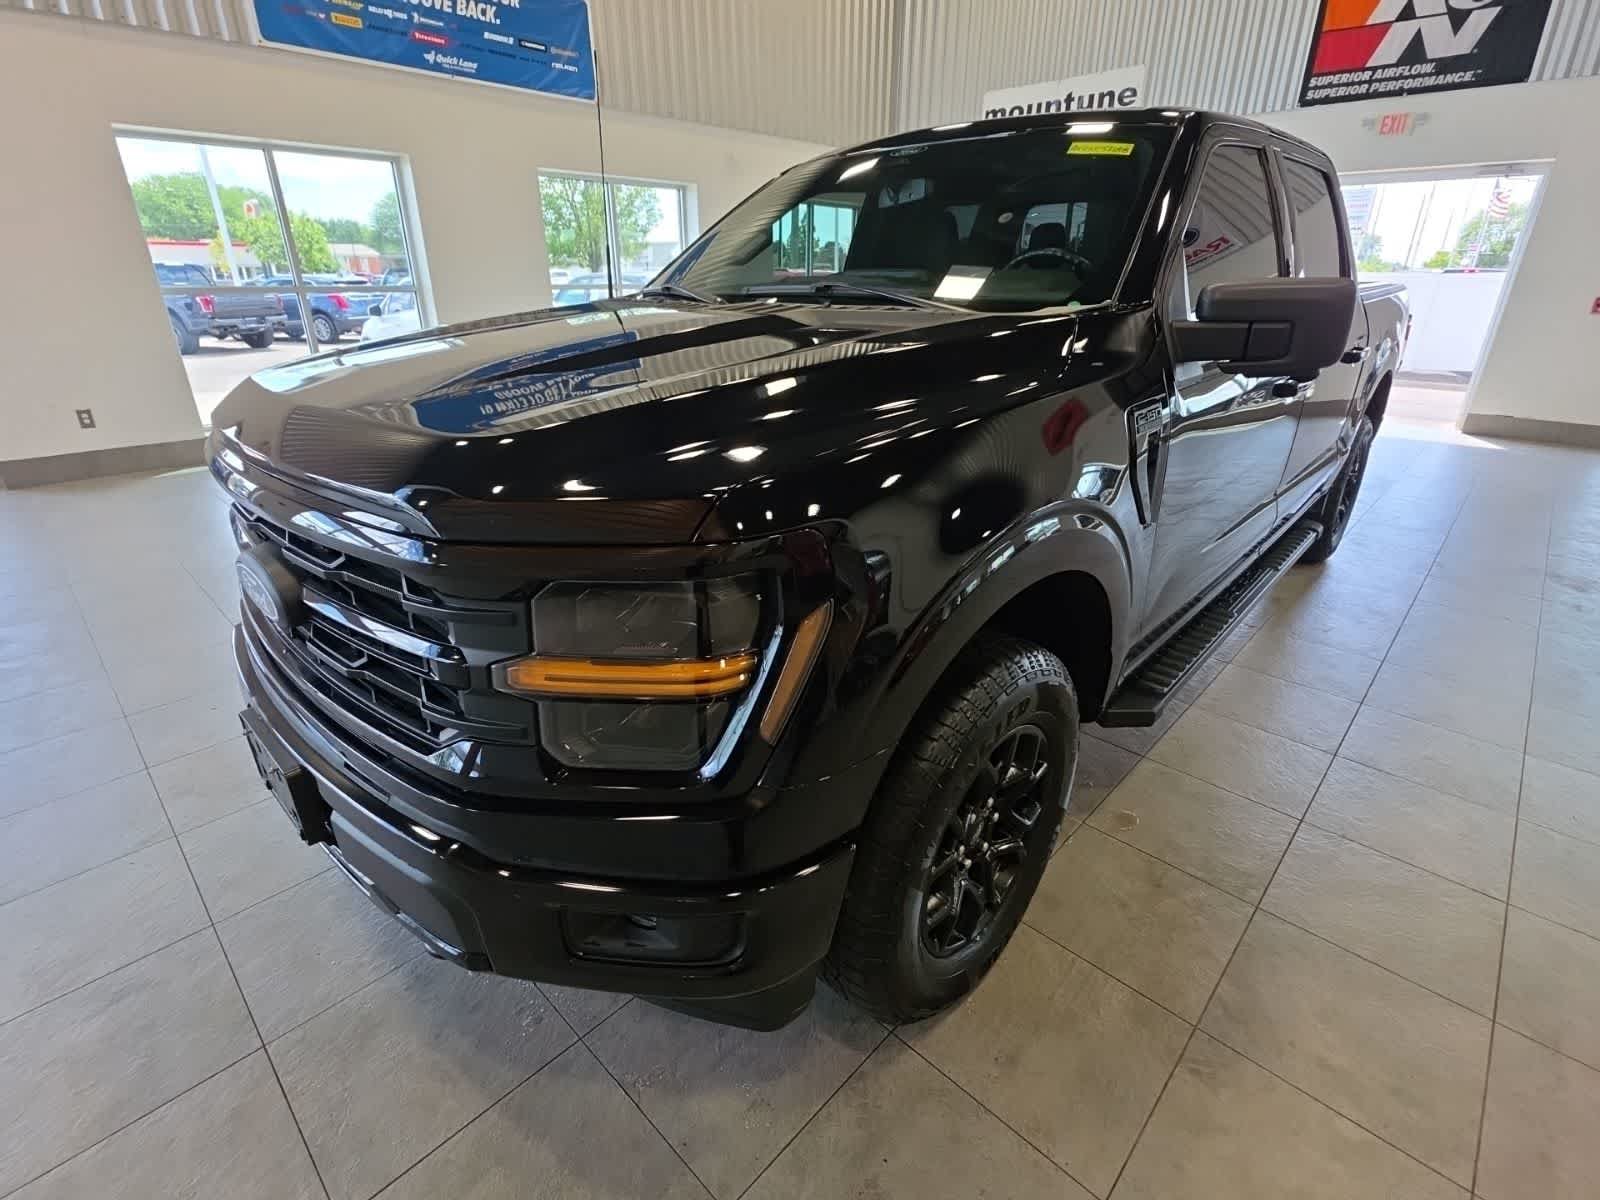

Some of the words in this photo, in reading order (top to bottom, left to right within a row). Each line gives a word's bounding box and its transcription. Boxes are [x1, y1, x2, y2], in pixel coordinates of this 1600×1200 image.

[456, 0, 500, 24] BACK.
[1309, 70, 1373, 87] SUPERIOR
[1374, 62, 1436, 82] AIRFLOW.
[985, 86, 1138, 120] mountune
[1306, 83, 1369, 99] SUPERIOR
[1379, 112, 1408, 136] EXIT
